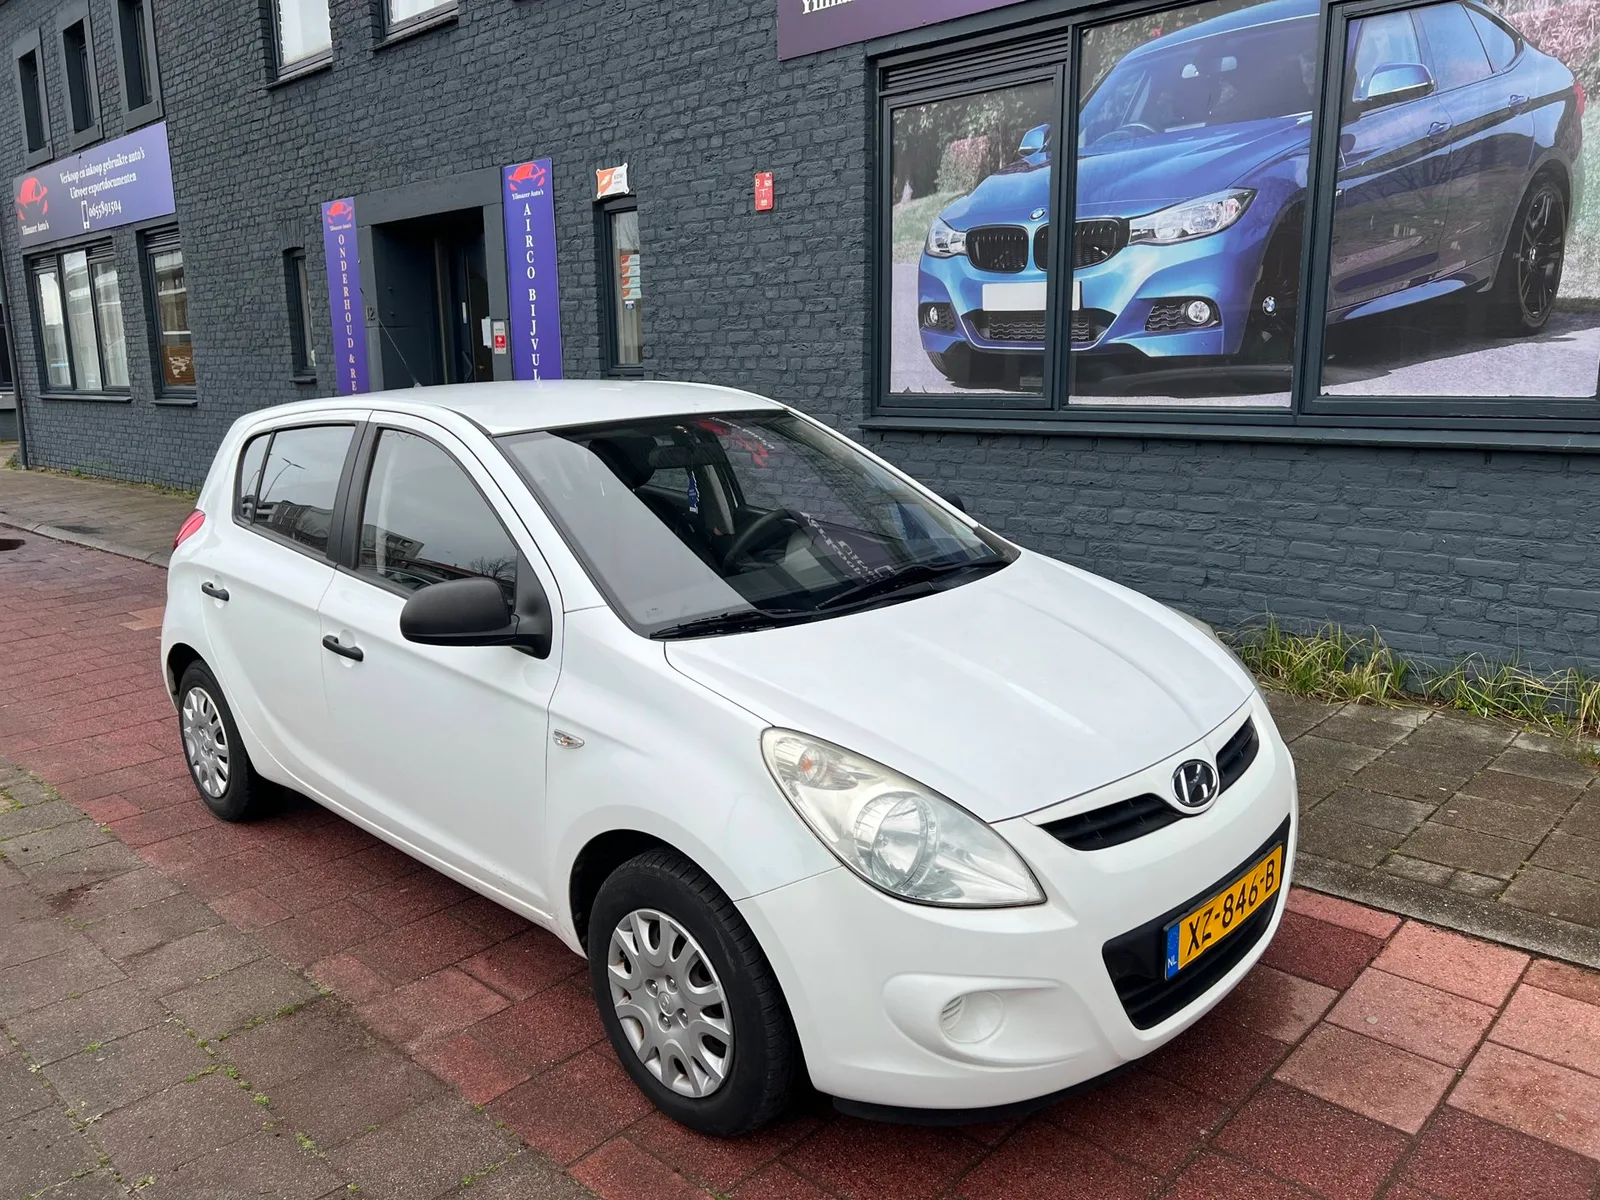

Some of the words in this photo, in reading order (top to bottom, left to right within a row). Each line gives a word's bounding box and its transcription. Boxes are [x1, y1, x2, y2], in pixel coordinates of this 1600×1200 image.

[60, 170, 79, 184] Verkoop
[85, 163, 102, 176] inkoop
[102, 154, 128, 175] gebruikte
[128, 147, 145, 163] auto's
[88, 173, 137, 196] exportdocumenten
[523, 203, 536, 280] AIRCO
[338, 234, 354, 349] ONDERHOUD
[348, 353, 355, 364] &
[1186, 858, 1275, 957] XZ-846-B
[1167, 956, 1177, 968] NL
